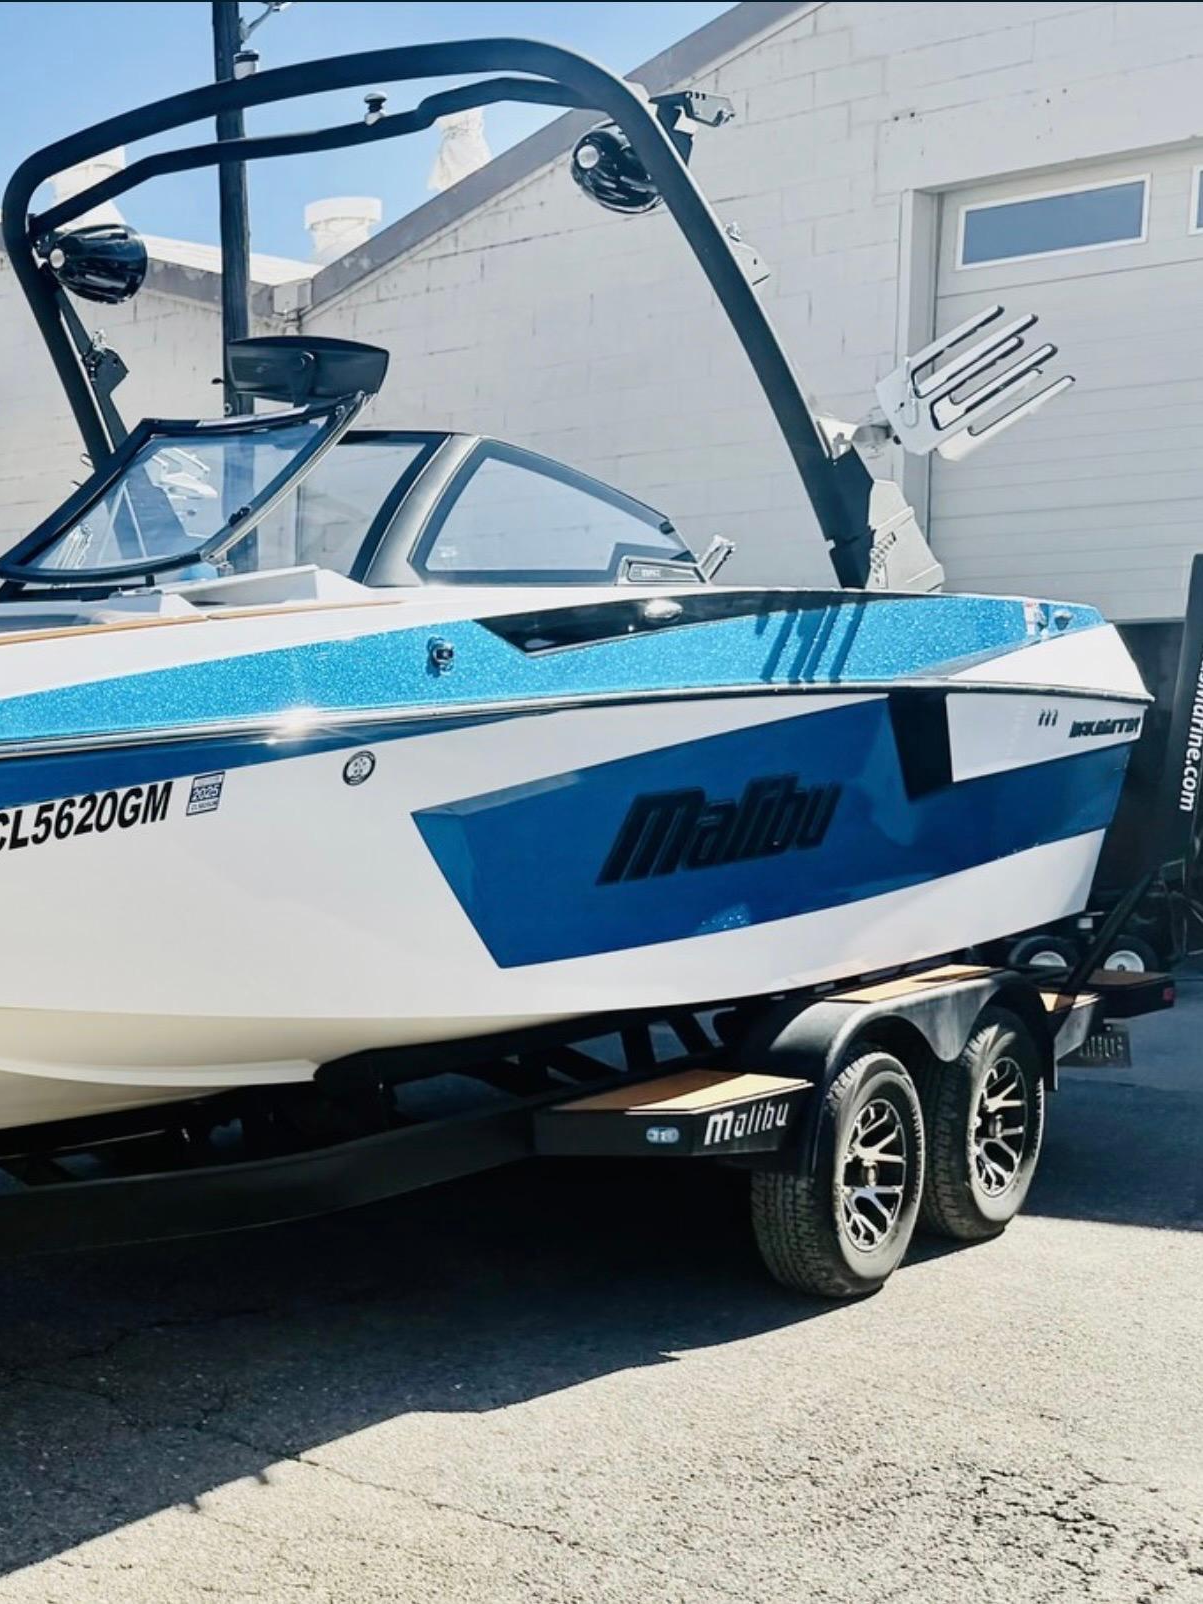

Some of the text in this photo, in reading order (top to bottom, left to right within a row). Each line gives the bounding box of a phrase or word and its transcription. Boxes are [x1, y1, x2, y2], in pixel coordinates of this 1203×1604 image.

[1179, 658, 1203, 811] arine.com
[191, 784, 220, 801] 2025
[595, 772, 843, 886] Malibu
